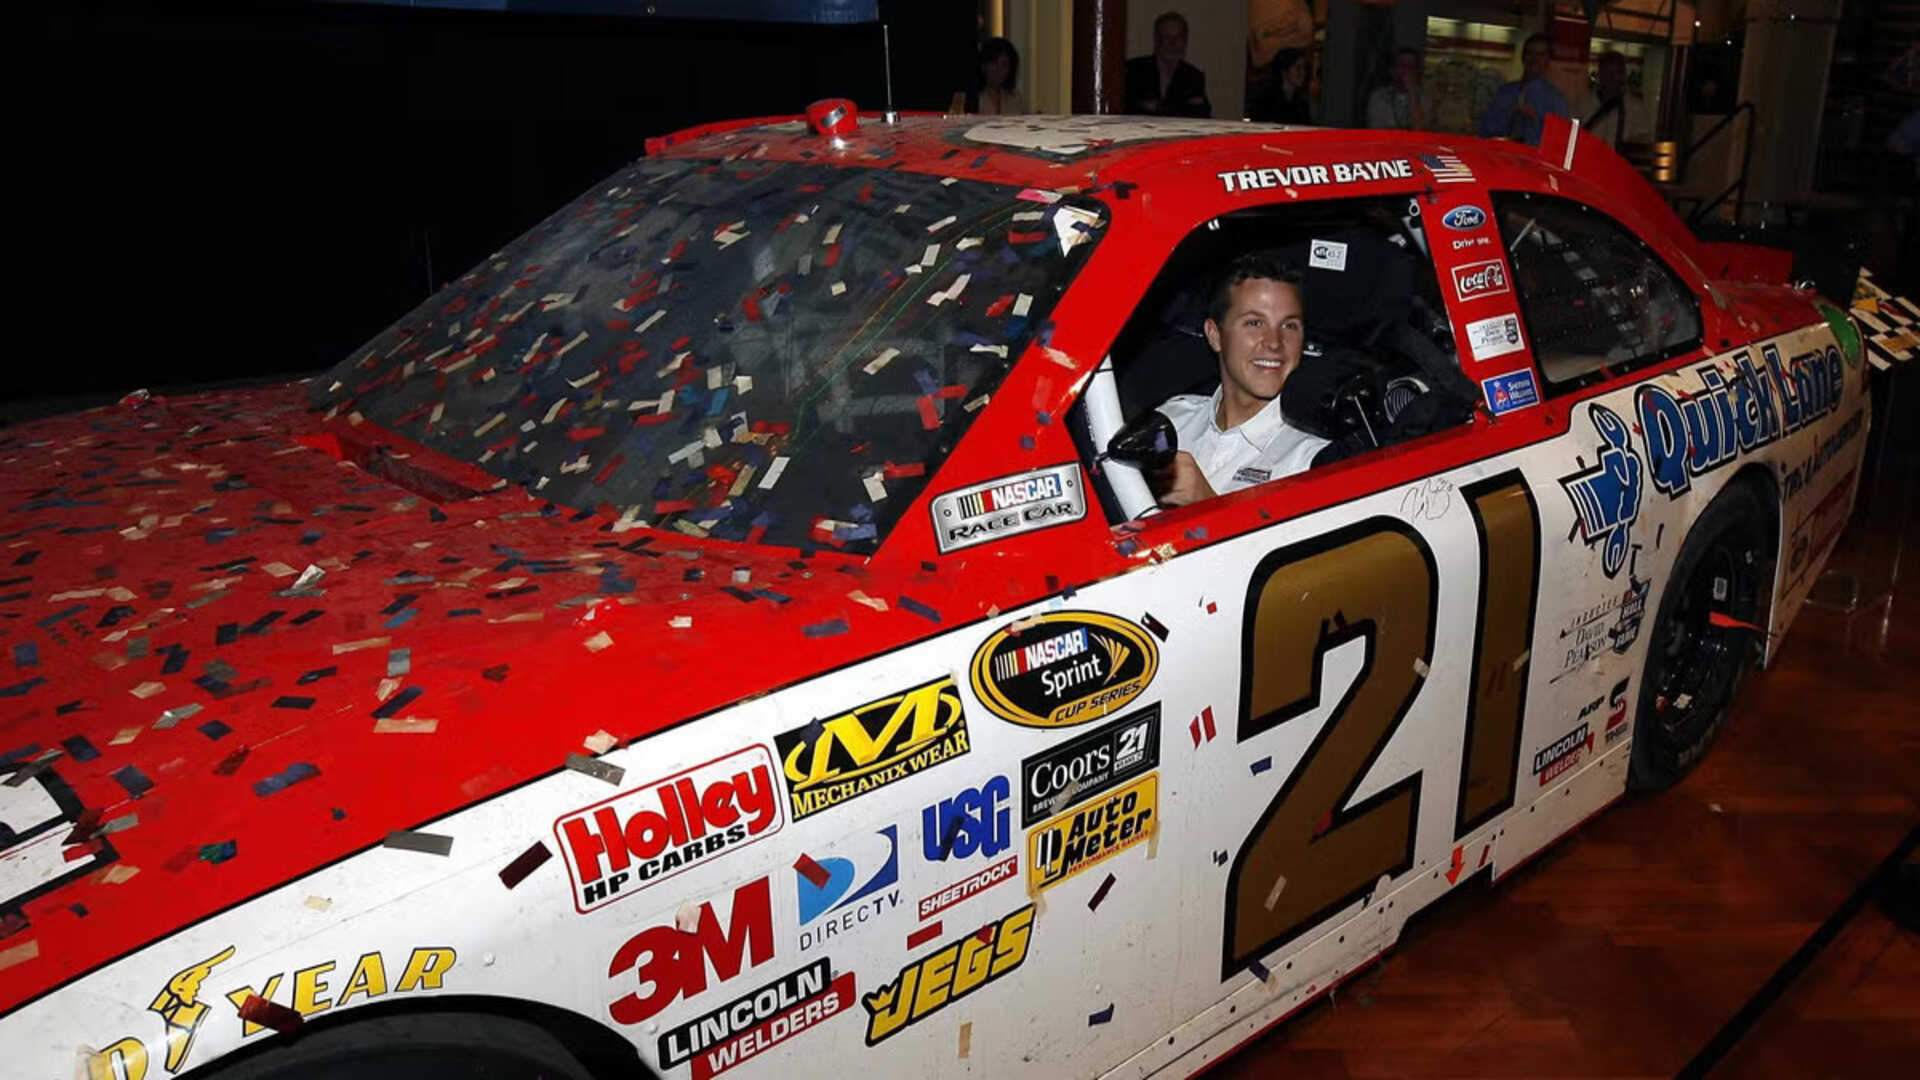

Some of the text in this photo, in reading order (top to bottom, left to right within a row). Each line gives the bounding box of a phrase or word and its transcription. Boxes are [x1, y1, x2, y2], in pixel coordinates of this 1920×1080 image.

[1218, 159, 1413, 193] TREVOR BAYNE
[1453, 208, 1480, 227] Ford
[1635, 352, 1782, 500] Quick
[1762, 345, 1843, 436] Lane
[948, 502, 1074, 541] RACE CAR
[991, 474, 1061, 510] NASCAR
[1025, 629, 1089, 672] NASCAR
[1041, 655, 1103, 698] Sprint
[1055, 682, 1141, 722] CUP SERIES
[1221, 466, 1542, 983] 21
[1031, 744, 1110, 798] Coors
[1116, 722, 1149, 761] 21
[1535, 727, 1588, 771] LINCOLN
[791, 728, 970, 820] MECHANIX WEAR
[562, 763, 778, 886] Holley
[921, 774, 1012, 864] USG
[1058, 807, 1153, 879] Meter
[1068, 791, 1139, 843] Auto
[584, 823, 749, 906] HP CARBS
[919, 861, 1015, 918] SHEETROCK
[608, 875, 776, 1026] 3M
[800, 889, 900, 952] DIRECTV
[225, 946, 457, 1039] YEAR
[871, 902, 1036, 1046] JEGS
[667, 963, 823, 1060] LINCOLN
[706, 990, 841, 1078] WELDERS
